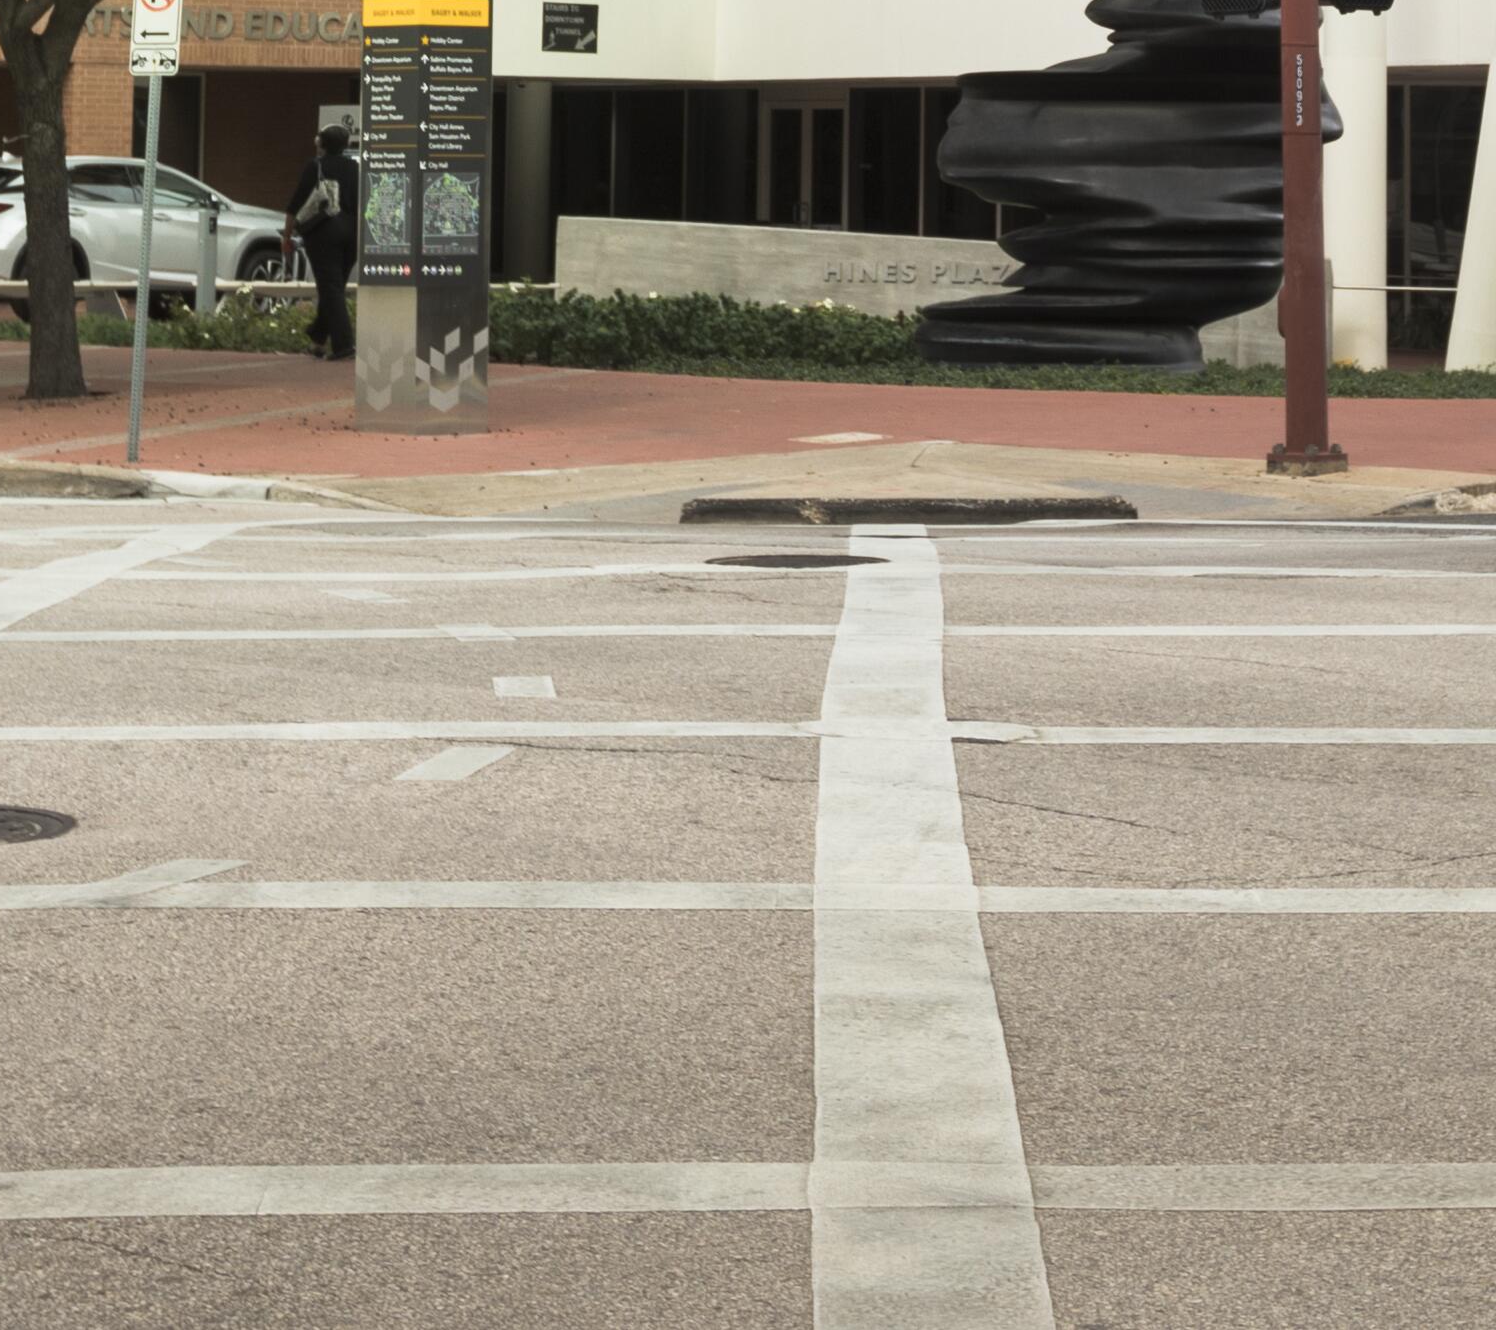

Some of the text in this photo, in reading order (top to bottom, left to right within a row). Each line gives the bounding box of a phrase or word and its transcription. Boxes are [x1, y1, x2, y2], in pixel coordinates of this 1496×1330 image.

[181, 7, 234, 38] ND
[244, 11, 362, 41] EDUCA
[824, 261, 1009, 285] HINES PLAZ
